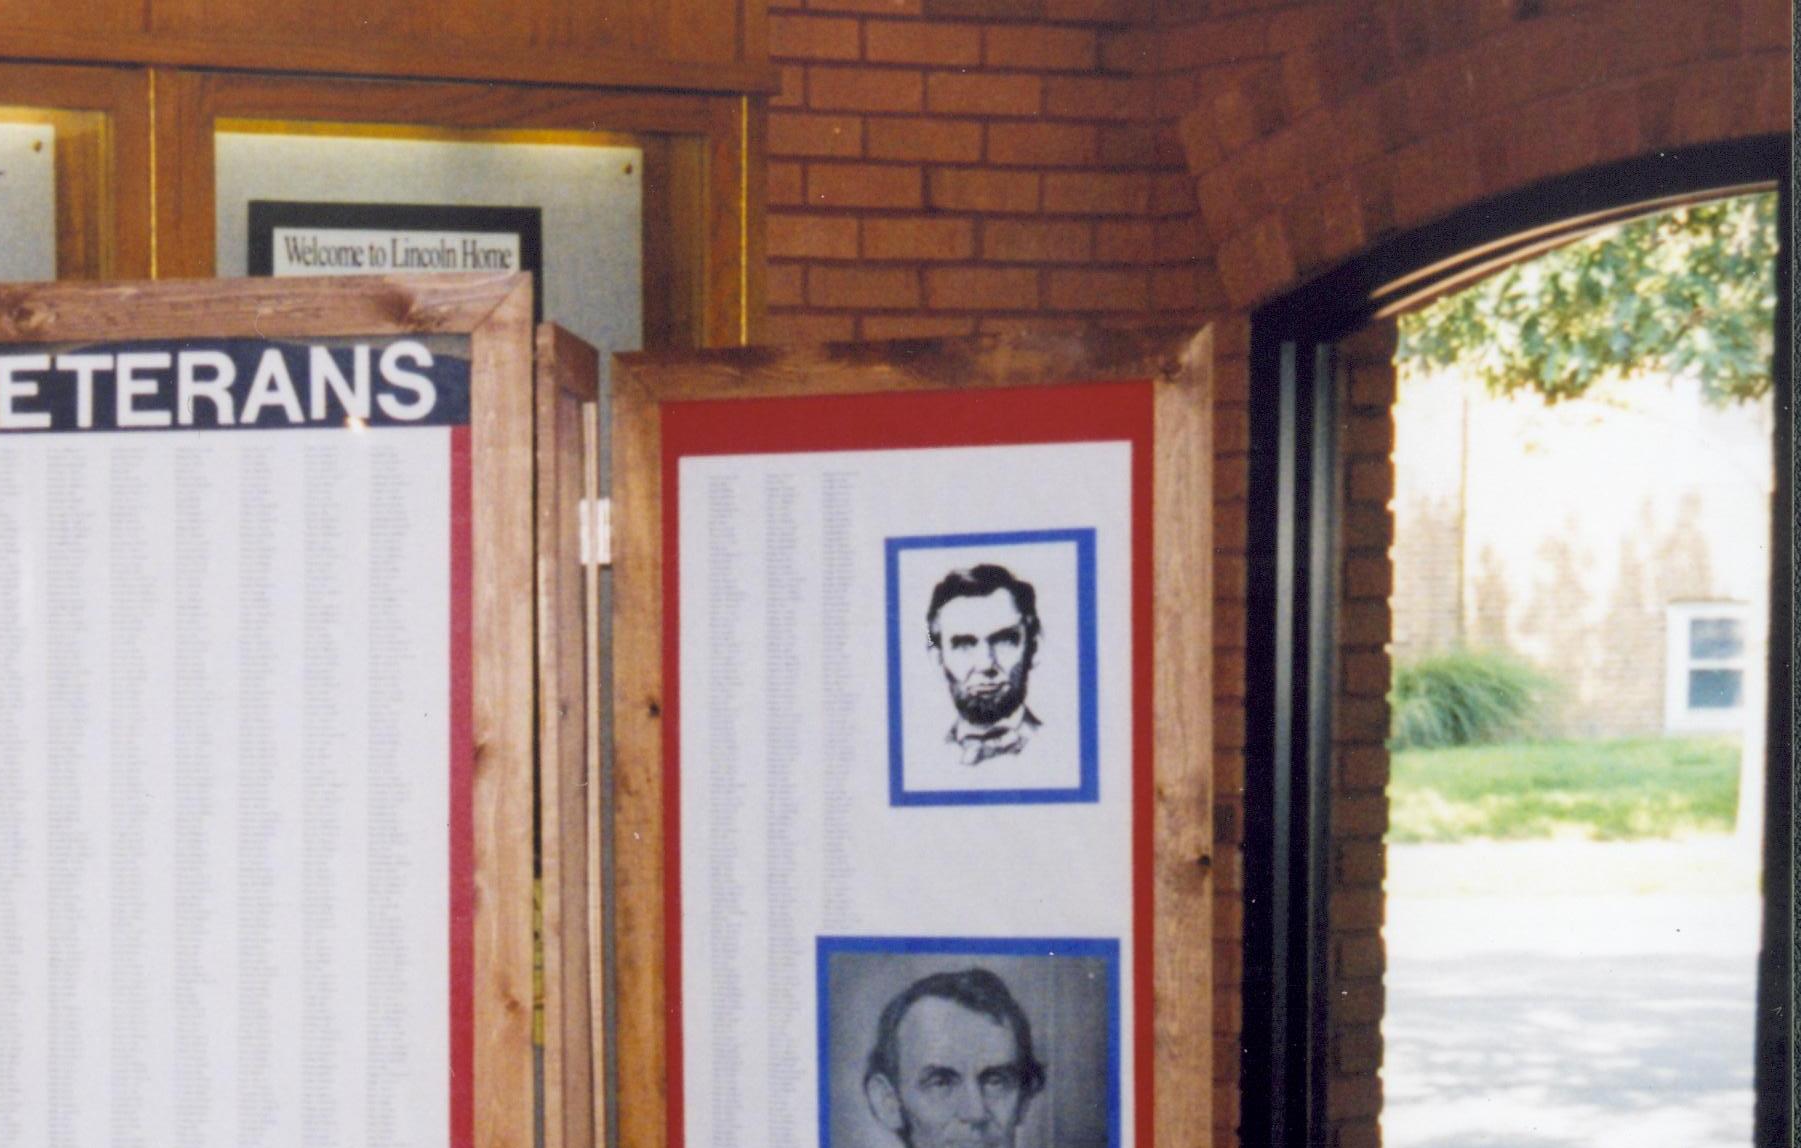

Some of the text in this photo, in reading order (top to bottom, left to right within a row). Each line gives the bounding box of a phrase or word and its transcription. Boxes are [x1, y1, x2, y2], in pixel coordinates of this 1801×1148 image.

[284, 235, 512, 269] Welcome to Lincoln Home
